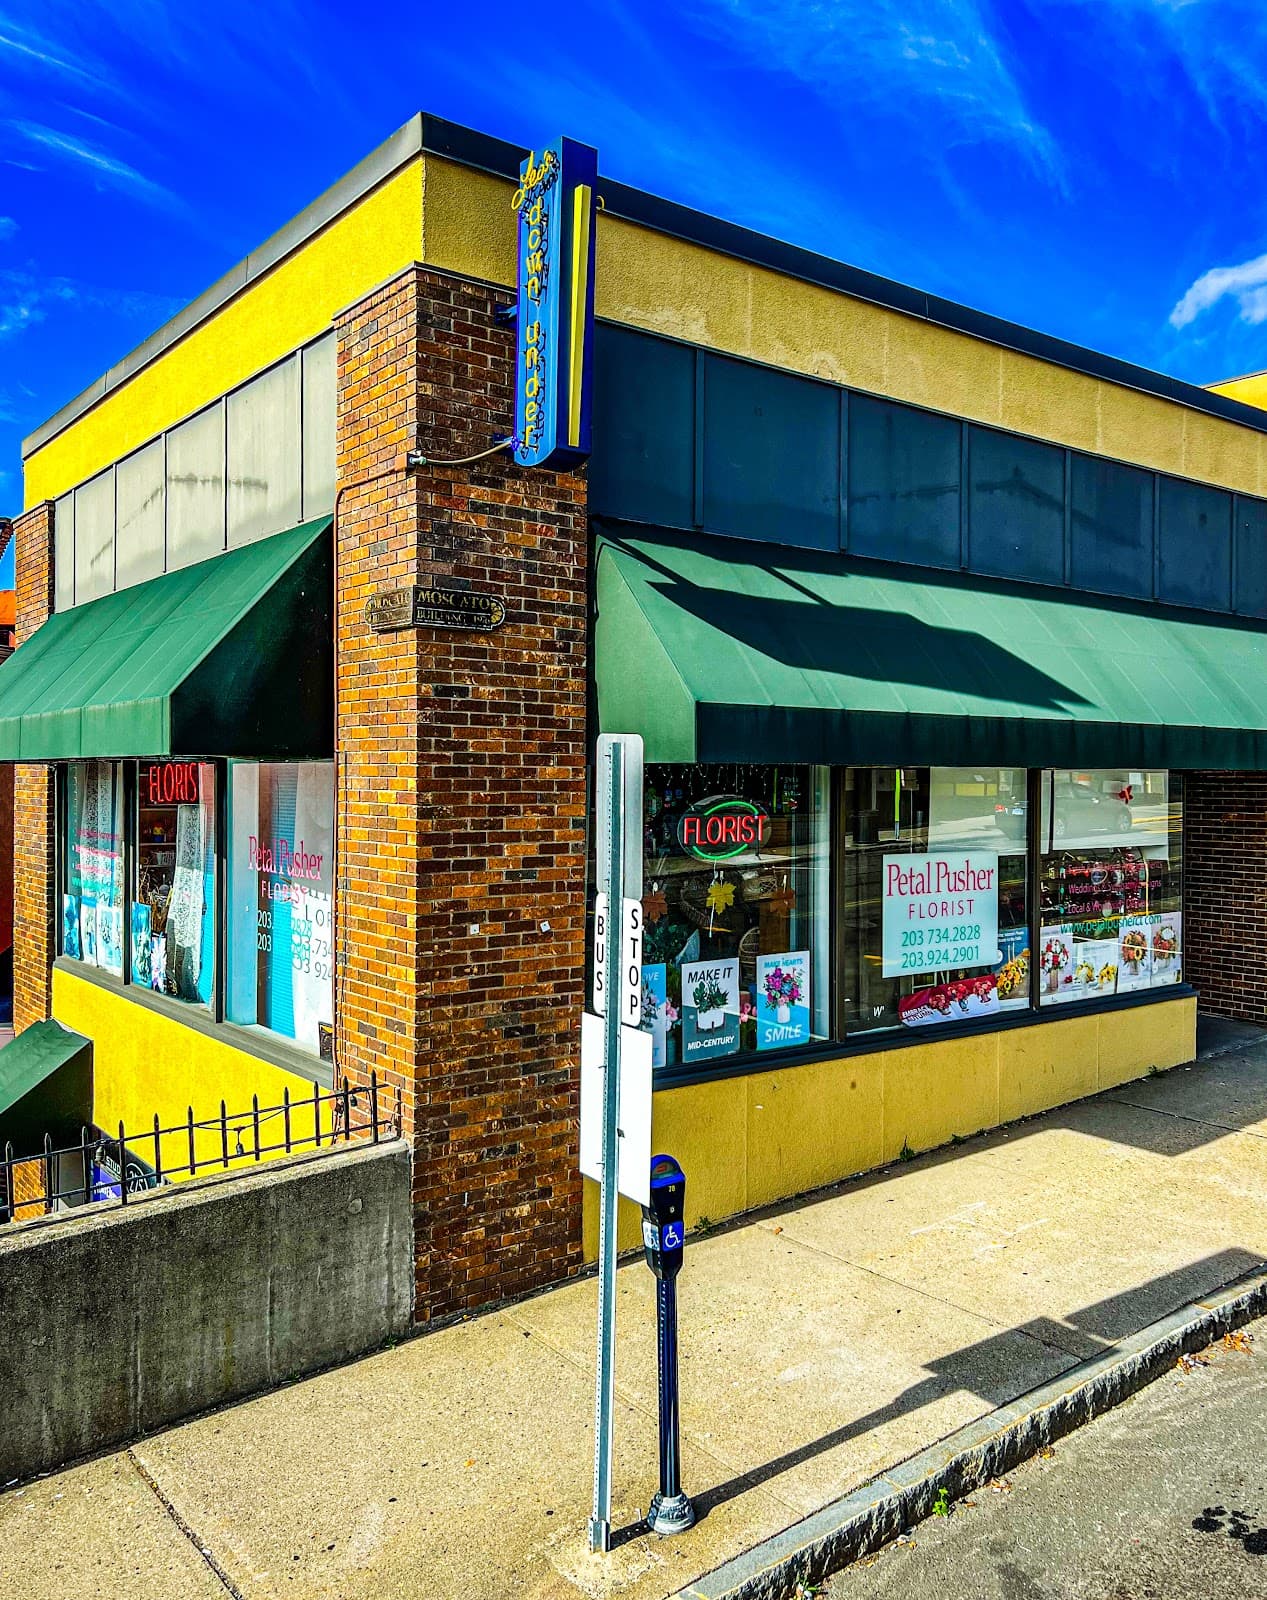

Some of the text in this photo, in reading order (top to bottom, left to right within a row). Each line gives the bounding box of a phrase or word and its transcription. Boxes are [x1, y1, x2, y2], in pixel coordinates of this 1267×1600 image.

[526, 196, 543, 301] down
[525, 321, 540, 447] under
[416, 590, 490, 610] MOSCATO
[149, 763, 207, 802] FLORIST
[684, 815, 768, 845] FLORIST
[248, 836, 323, 881] Petal Pusher
[886, 859, 994, 897] Petal Pusher
[909, 899, 974, 920] FLORIST
[596, 915, 605, 991] BUS
[629, 908, 639, 1015] STOP
[764, 958, 803, 968] MAKE HEARTS
[901, 945, 979, 969] 203.924.2901
[688, 967, 734, 984] MAKE IT
[687, 1035, 735, 1051] MID-CENTURY
[765, 1024, 802, 1043] SMILE
